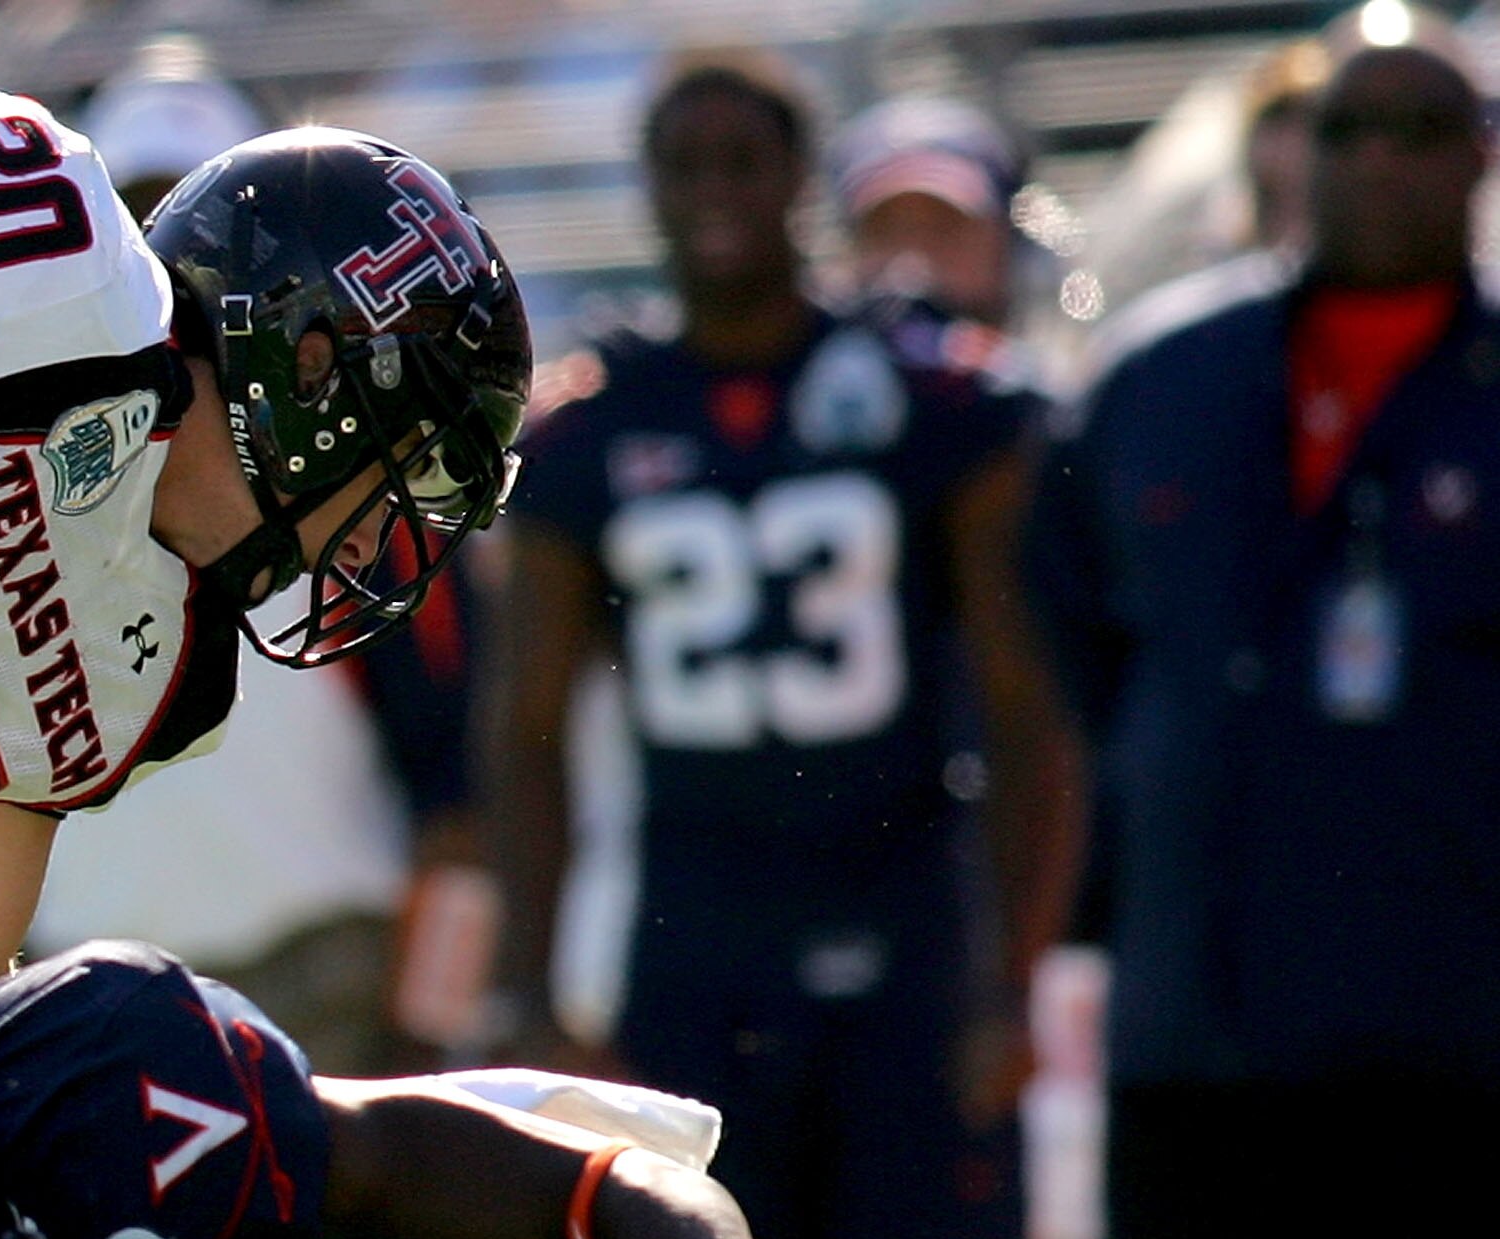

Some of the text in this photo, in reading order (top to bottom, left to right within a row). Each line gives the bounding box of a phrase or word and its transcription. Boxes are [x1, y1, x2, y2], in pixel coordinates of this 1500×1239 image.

[603, 472, 906, 750] 23
[26, 636, 109, 790] TECH
[138, 1071, 250, 1208] V
